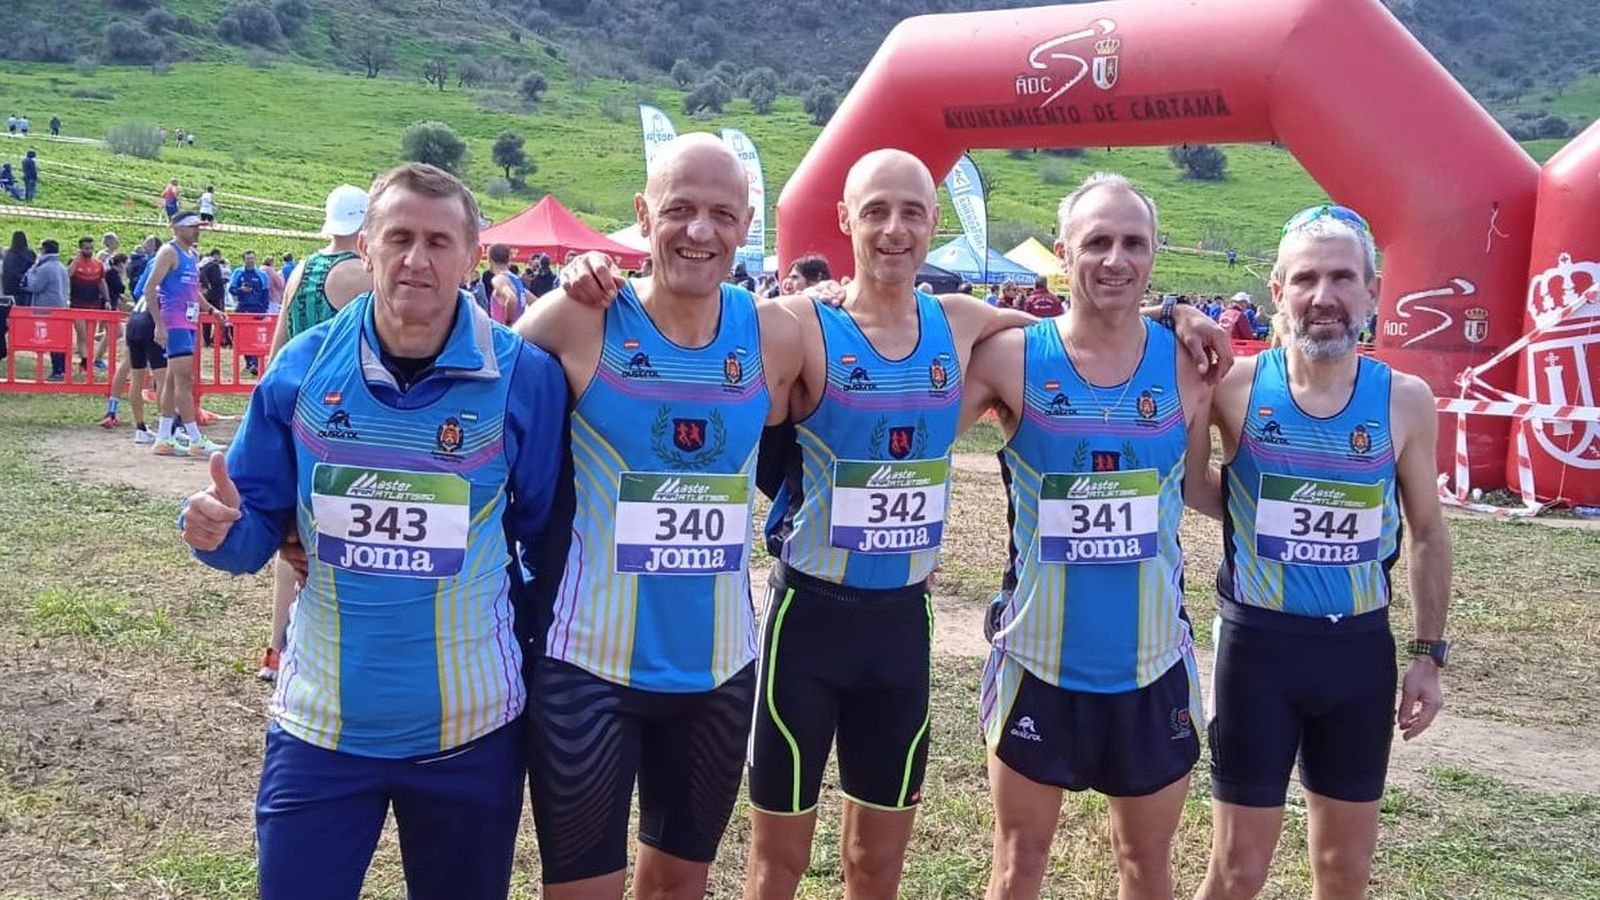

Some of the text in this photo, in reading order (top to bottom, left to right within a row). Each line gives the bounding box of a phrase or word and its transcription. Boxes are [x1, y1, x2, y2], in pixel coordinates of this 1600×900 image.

[944, 105, 1082, 128] AYUNTAMIENTO
[1094, 103, 1118, 121] DE
[347, 503, 428, 542] 343
[868, 491, 926, 523] 342
[1071, 502, 1132, 534] 341
[655, 507, 725, 541] 340
[1290, 507, 1358, 540] 344
